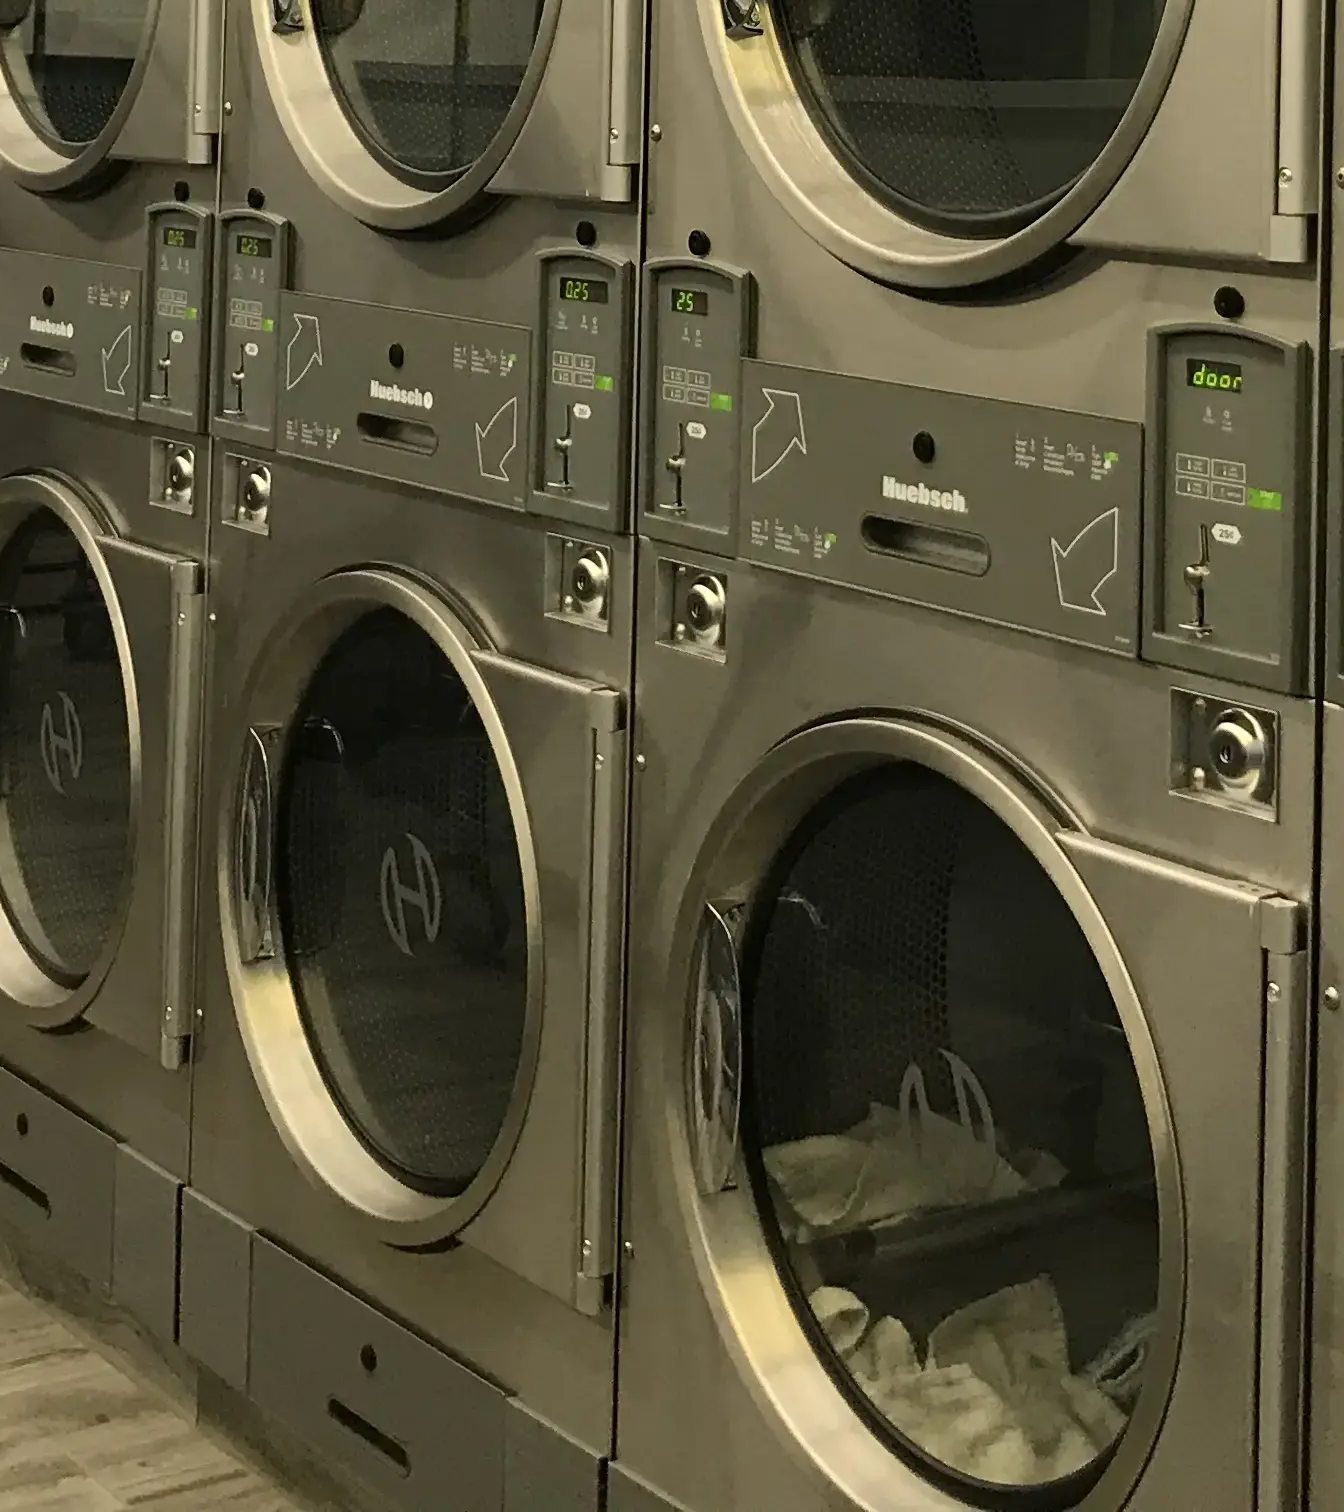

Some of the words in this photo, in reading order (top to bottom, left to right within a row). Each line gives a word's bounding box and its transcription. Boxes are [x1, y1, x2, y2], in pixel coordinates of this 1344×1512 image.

[565, 280, 589, 301] 0.25
[676, 292, 694, 312] 25
[1193, 363, 1242, 389] door
[370, 379, 423, 407] Huebsch
[883, 475, 966, 513] Huebsch
